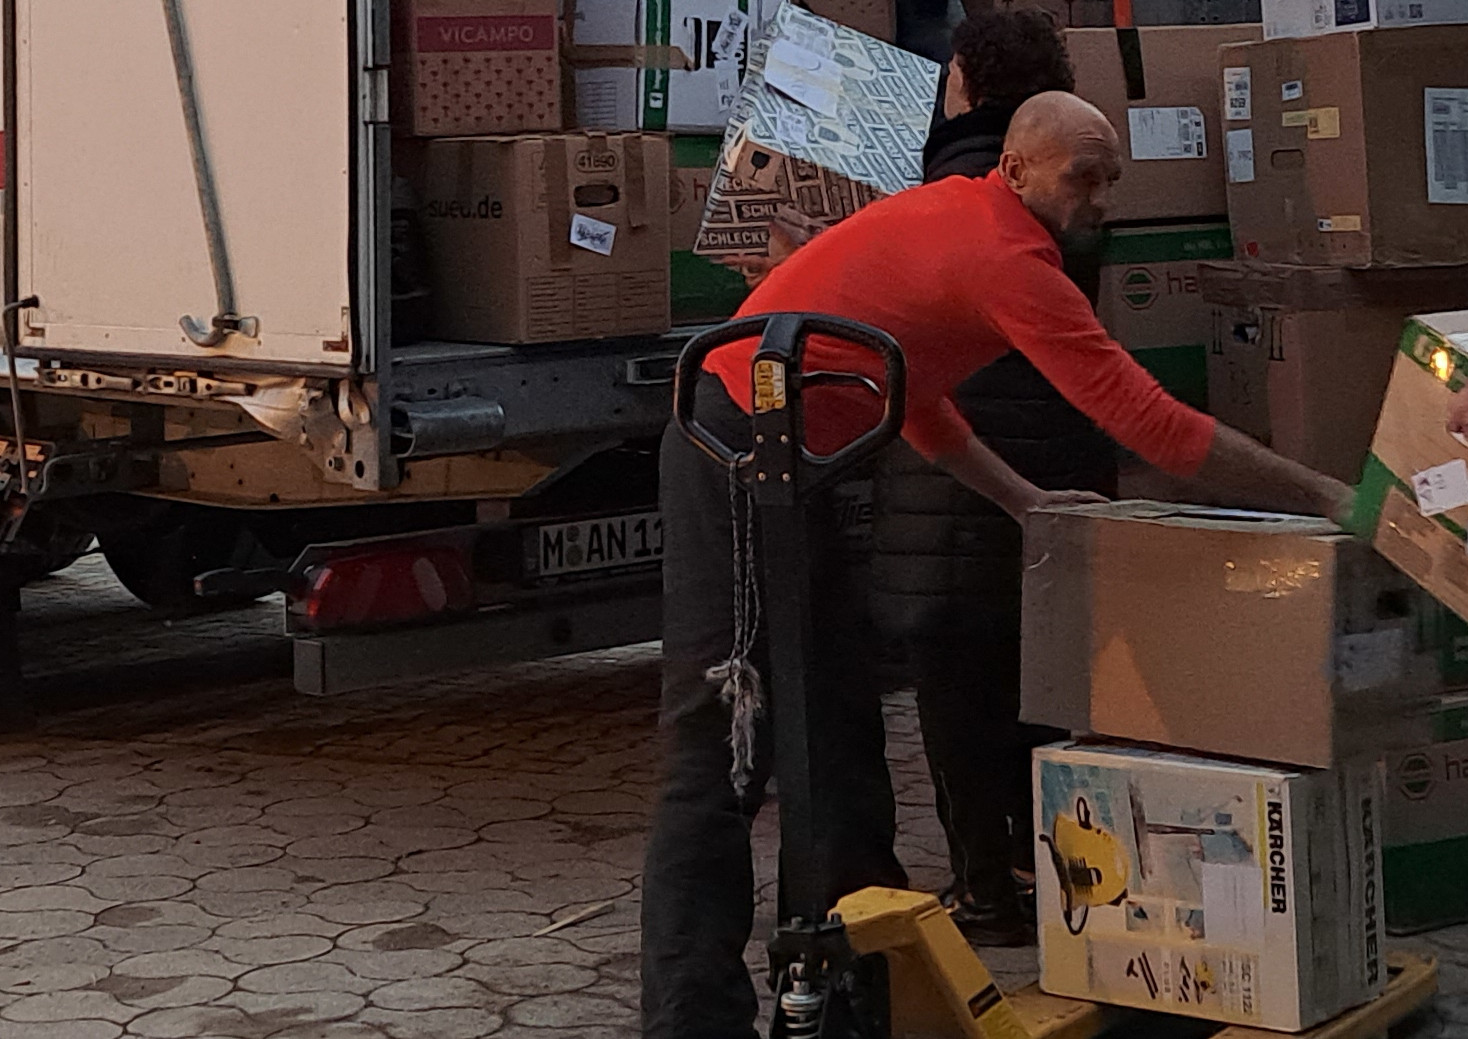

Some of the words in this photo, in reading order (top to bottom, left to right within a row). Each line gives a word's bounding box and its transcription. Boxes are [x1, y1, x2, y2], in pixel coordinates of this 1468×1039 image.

[439, 25, 534, 43] VICAMPO
[543, 529, 564, 569] M
[586, 520, 627, 563] AN
